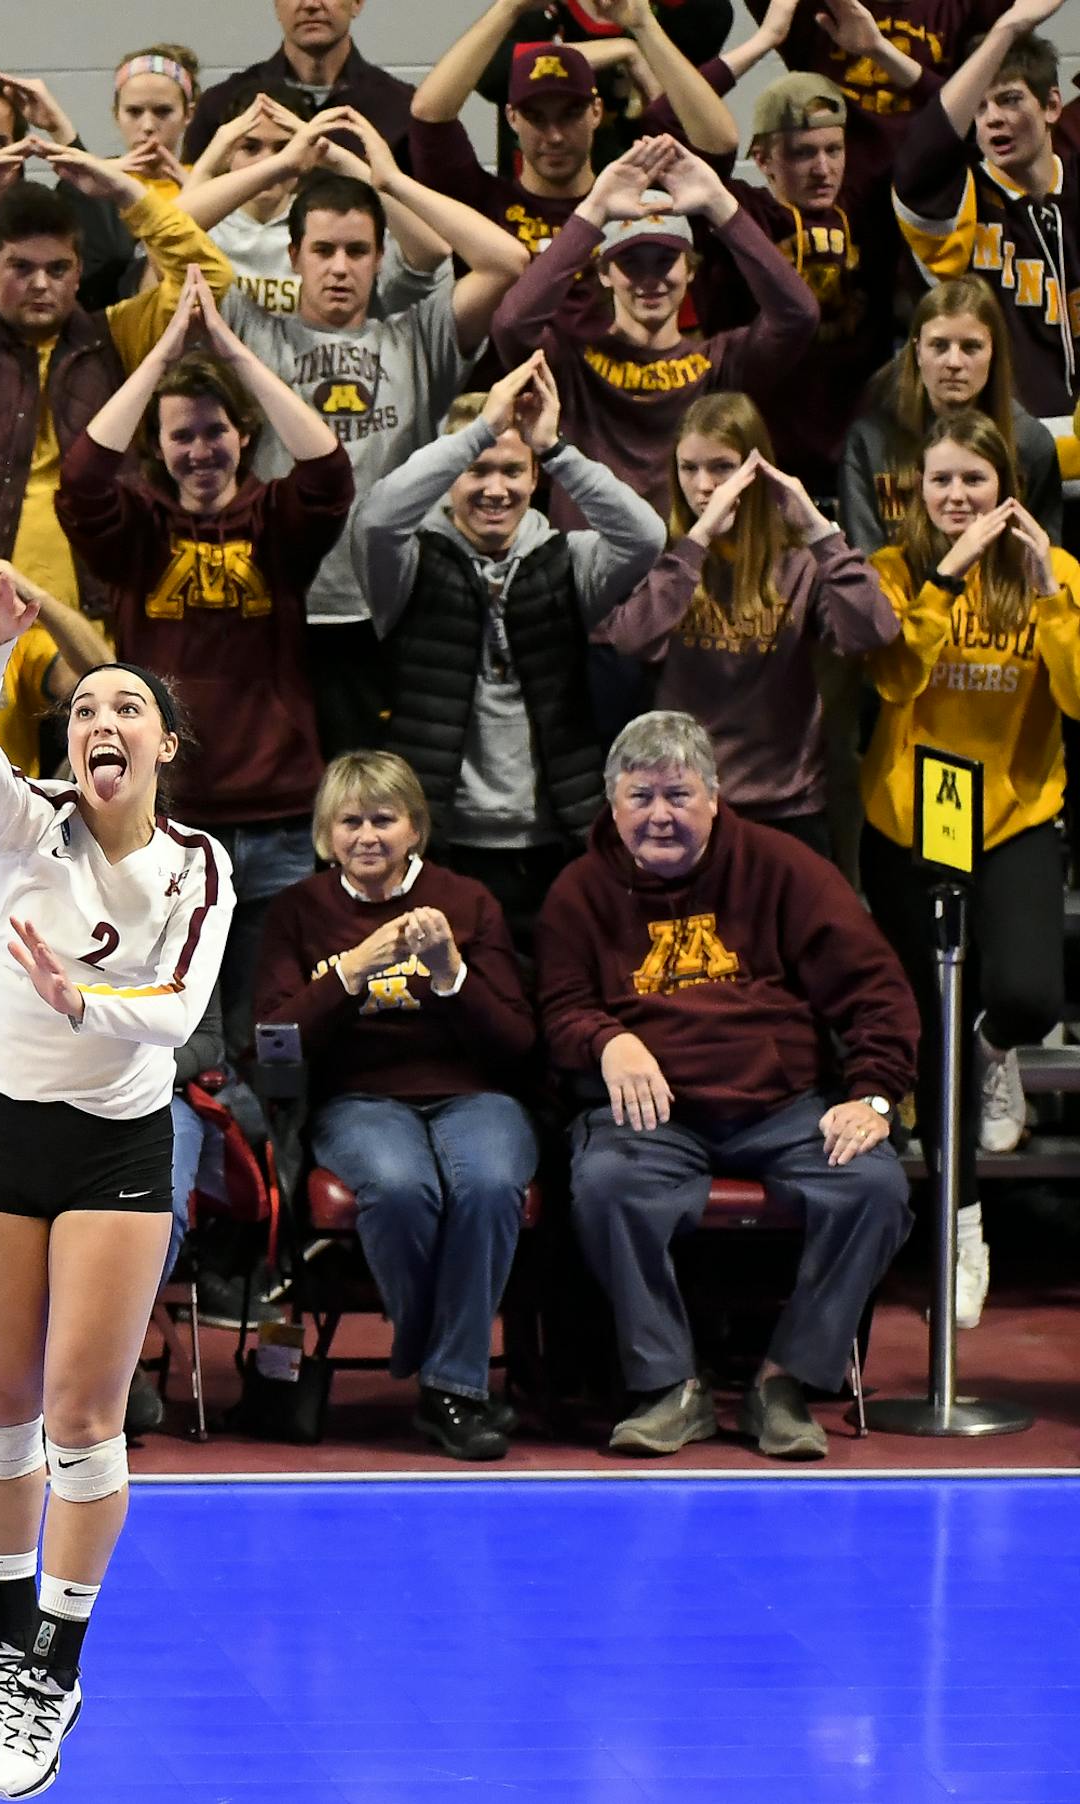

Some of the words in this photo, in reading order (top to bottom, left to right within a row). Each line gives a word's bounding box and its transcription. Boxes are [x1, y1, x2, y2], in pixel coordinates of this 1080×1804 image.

[324, 405, 399, 442] HERS
[936, 767, 962, 811] M
[76, 920, 120, 972] 2
